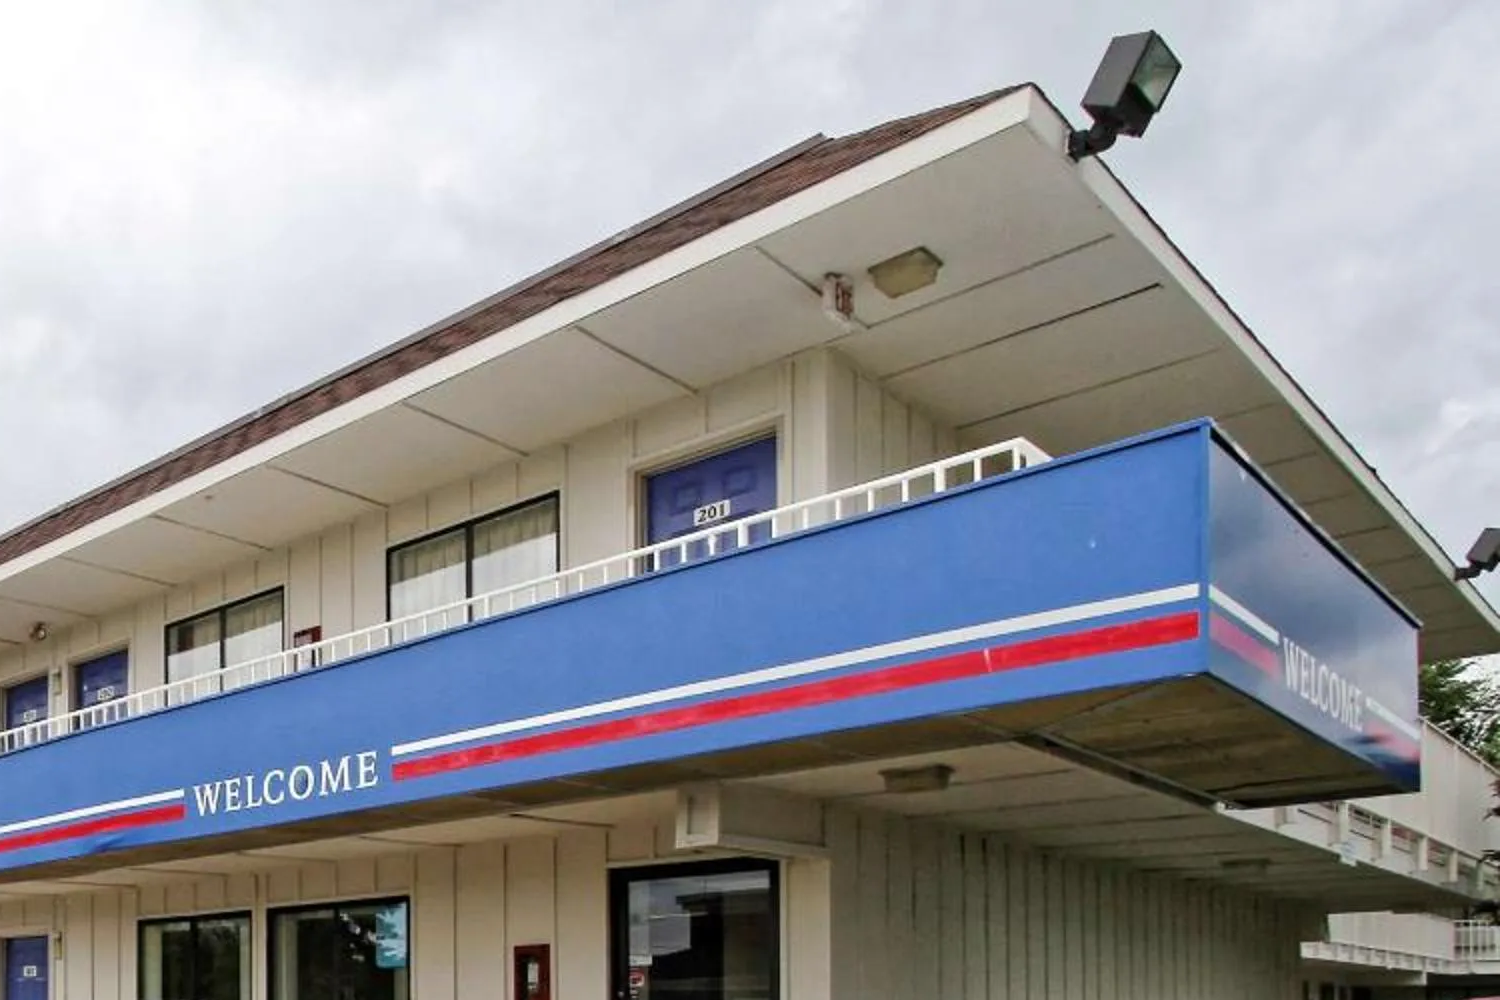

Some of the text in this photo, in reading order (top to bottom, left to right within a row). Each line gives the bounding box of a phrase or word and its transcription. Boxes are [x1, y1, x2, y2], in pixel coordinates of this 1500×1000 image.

[698, 503, 726, 523] 201
[1283, 636, 1362, 732] WELCOME
[193, 750, 379, 817] WELCOME
